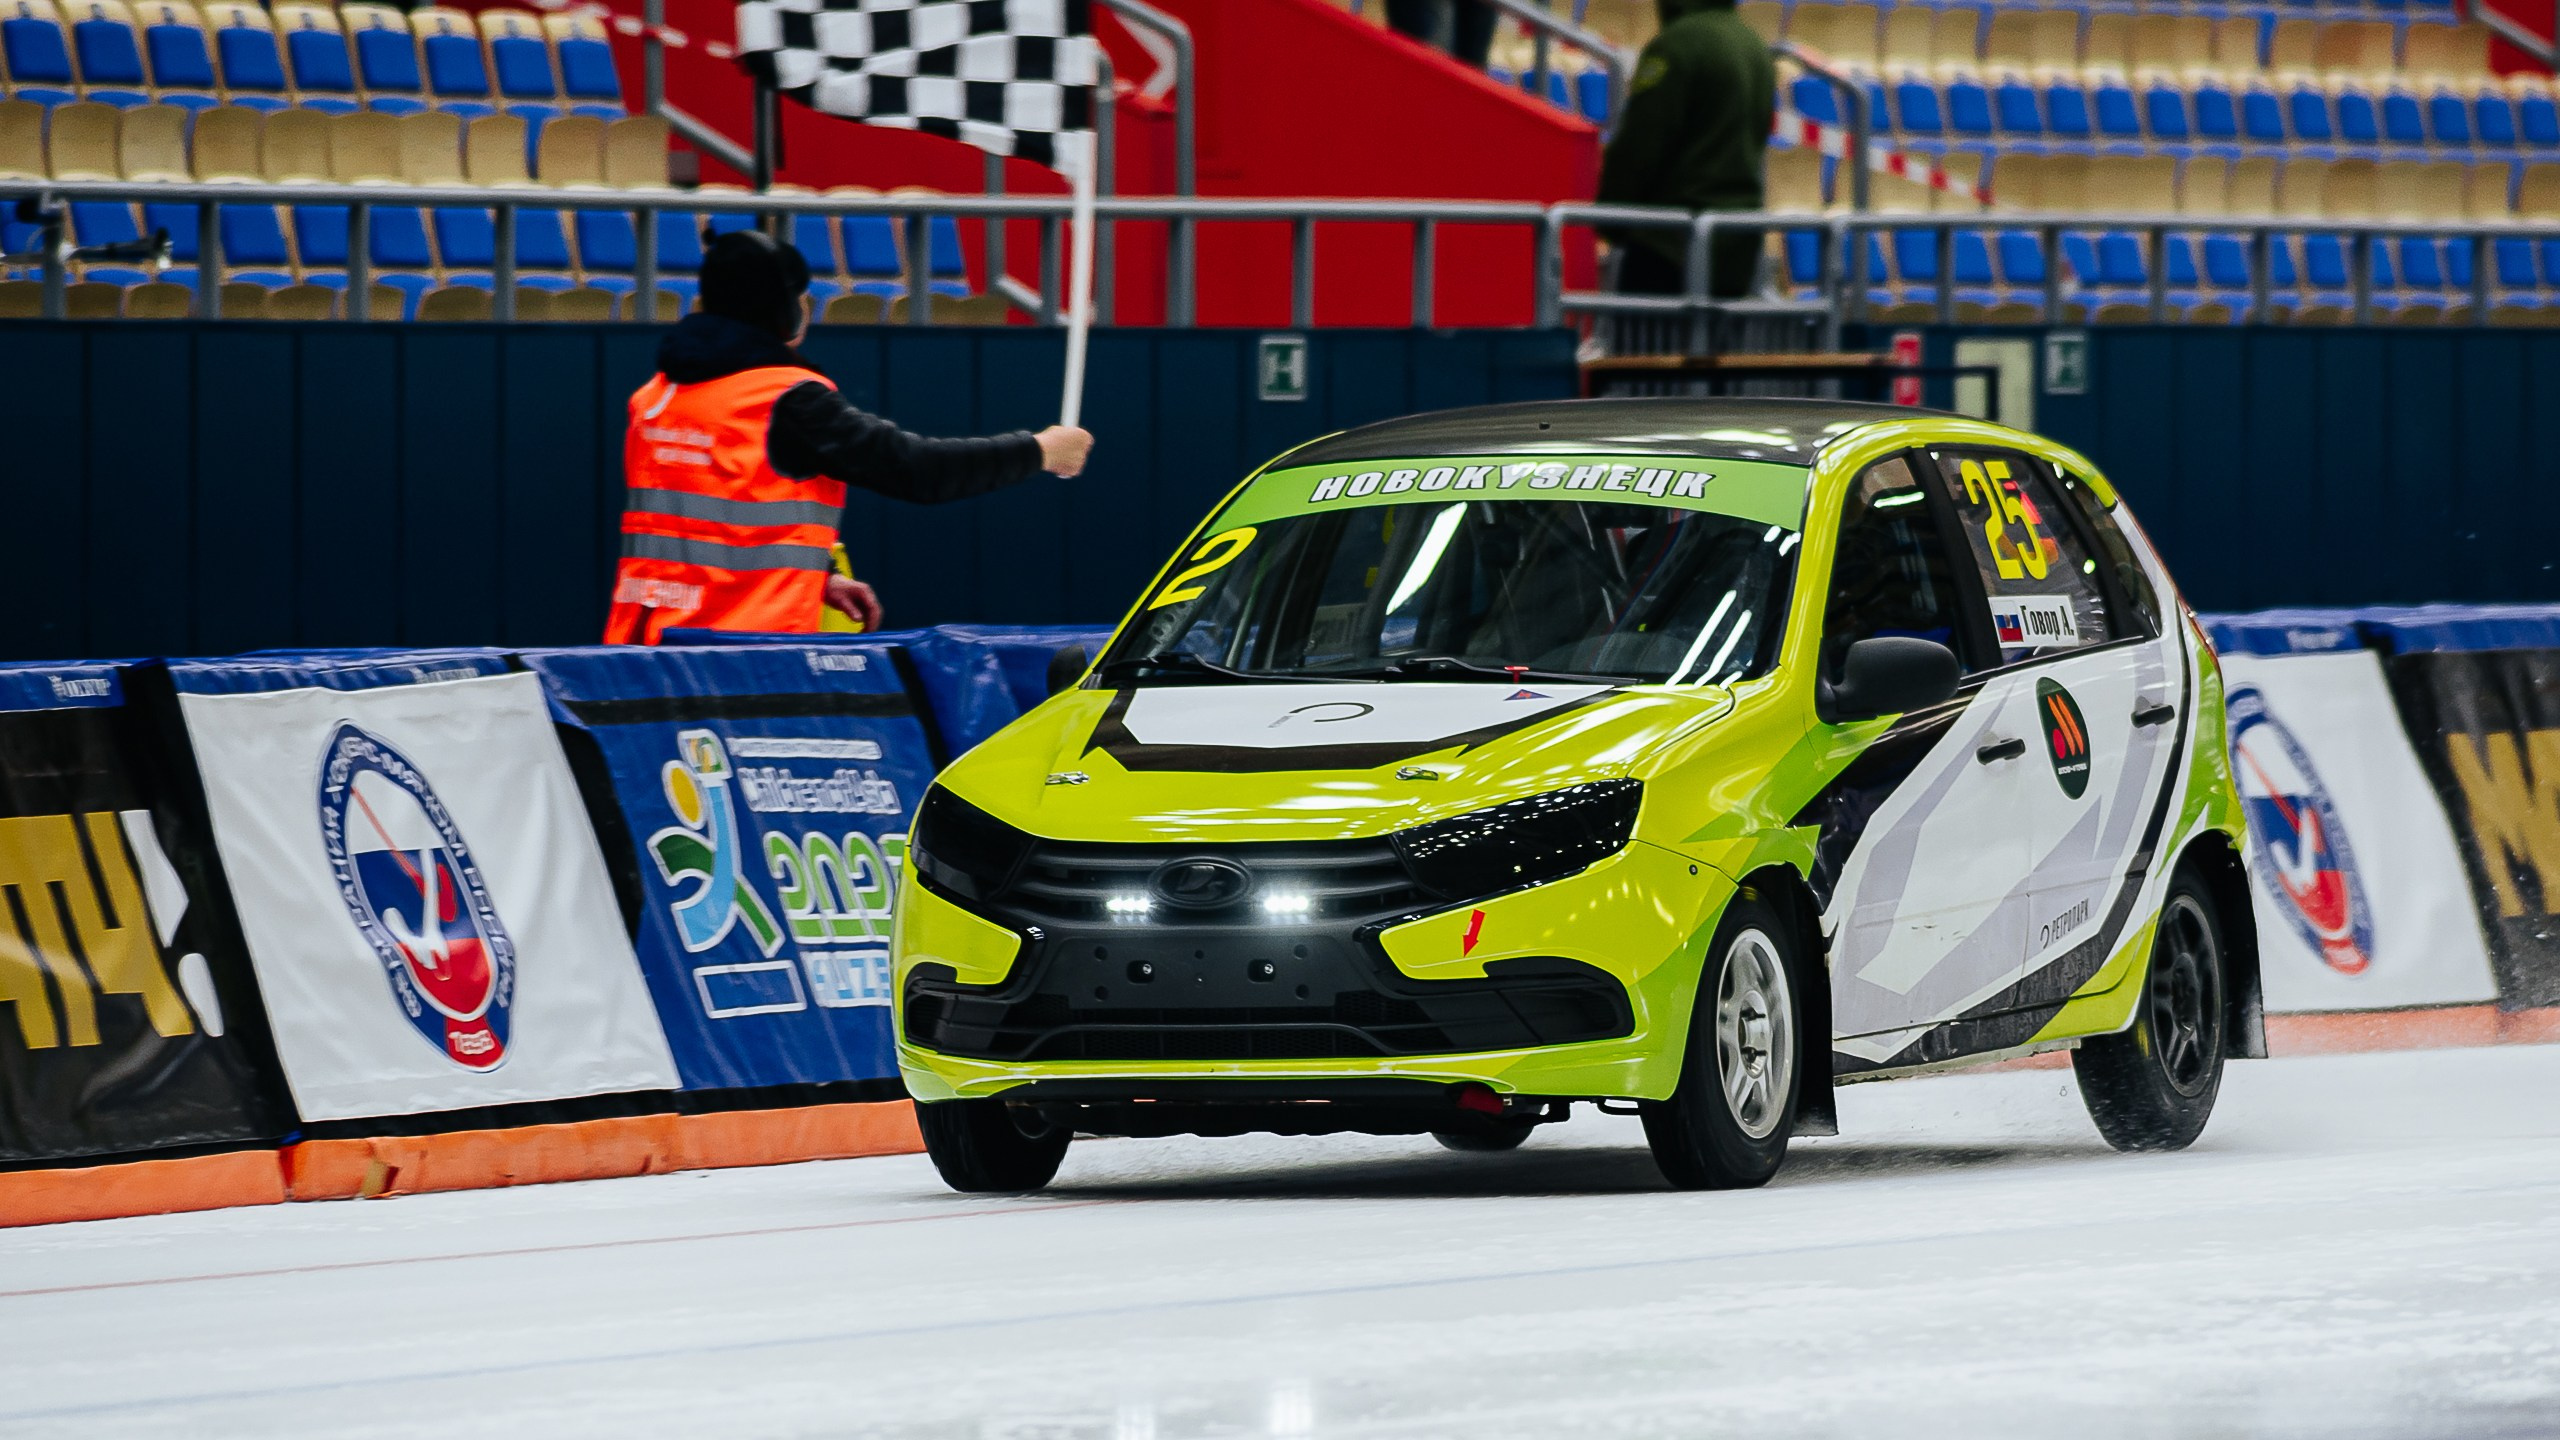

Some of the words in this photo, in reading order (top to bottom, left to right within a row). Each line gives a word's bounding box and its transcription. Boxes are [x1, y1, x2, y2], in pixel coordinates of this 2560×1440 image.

[1308, 463, 1717, 503] НОВОКУЗНЕЦК
[1960, 460, 2048, 580] 25
[1146, 526, 1258, 611] 2
[2020, 605, 2060, 642] Говор
[2059, 605, 2075, 637] А.
[2051, 898, 2089, 943] РЕТРОПАРК
